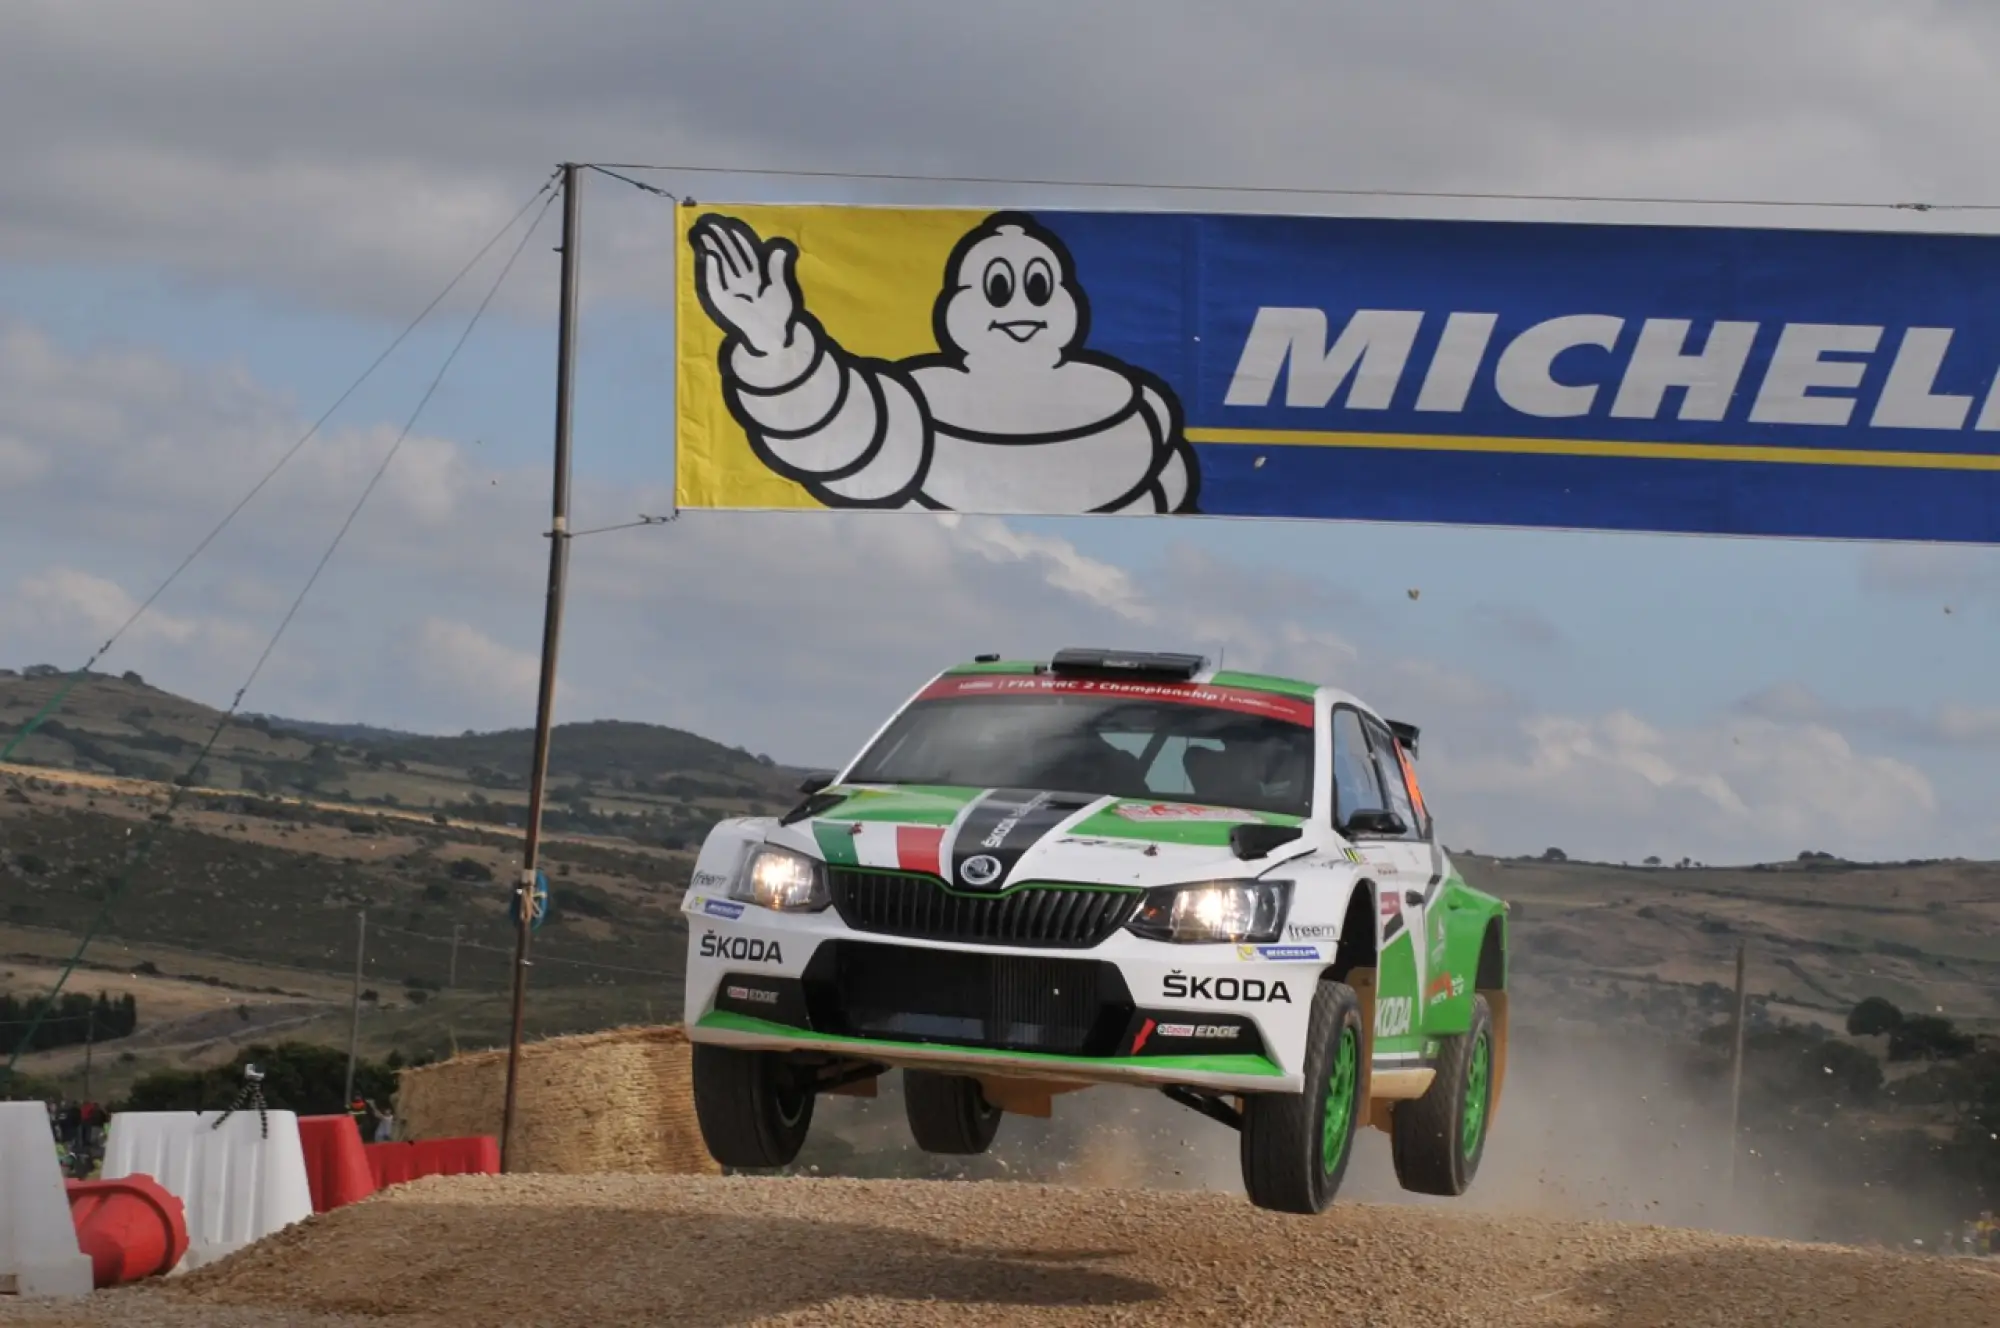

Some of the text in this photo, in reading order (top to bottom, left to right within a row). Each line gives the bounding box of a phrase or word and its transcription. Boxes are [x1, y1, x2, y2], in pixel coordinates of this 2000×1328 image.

[1099, 683, 1218, 701] Championship
[700, 929, 784, 964] ŠKODA
[1162, 969, 1293, 1004] ŠKODA
[1195, 1025, 1242, 1038] EDGE
